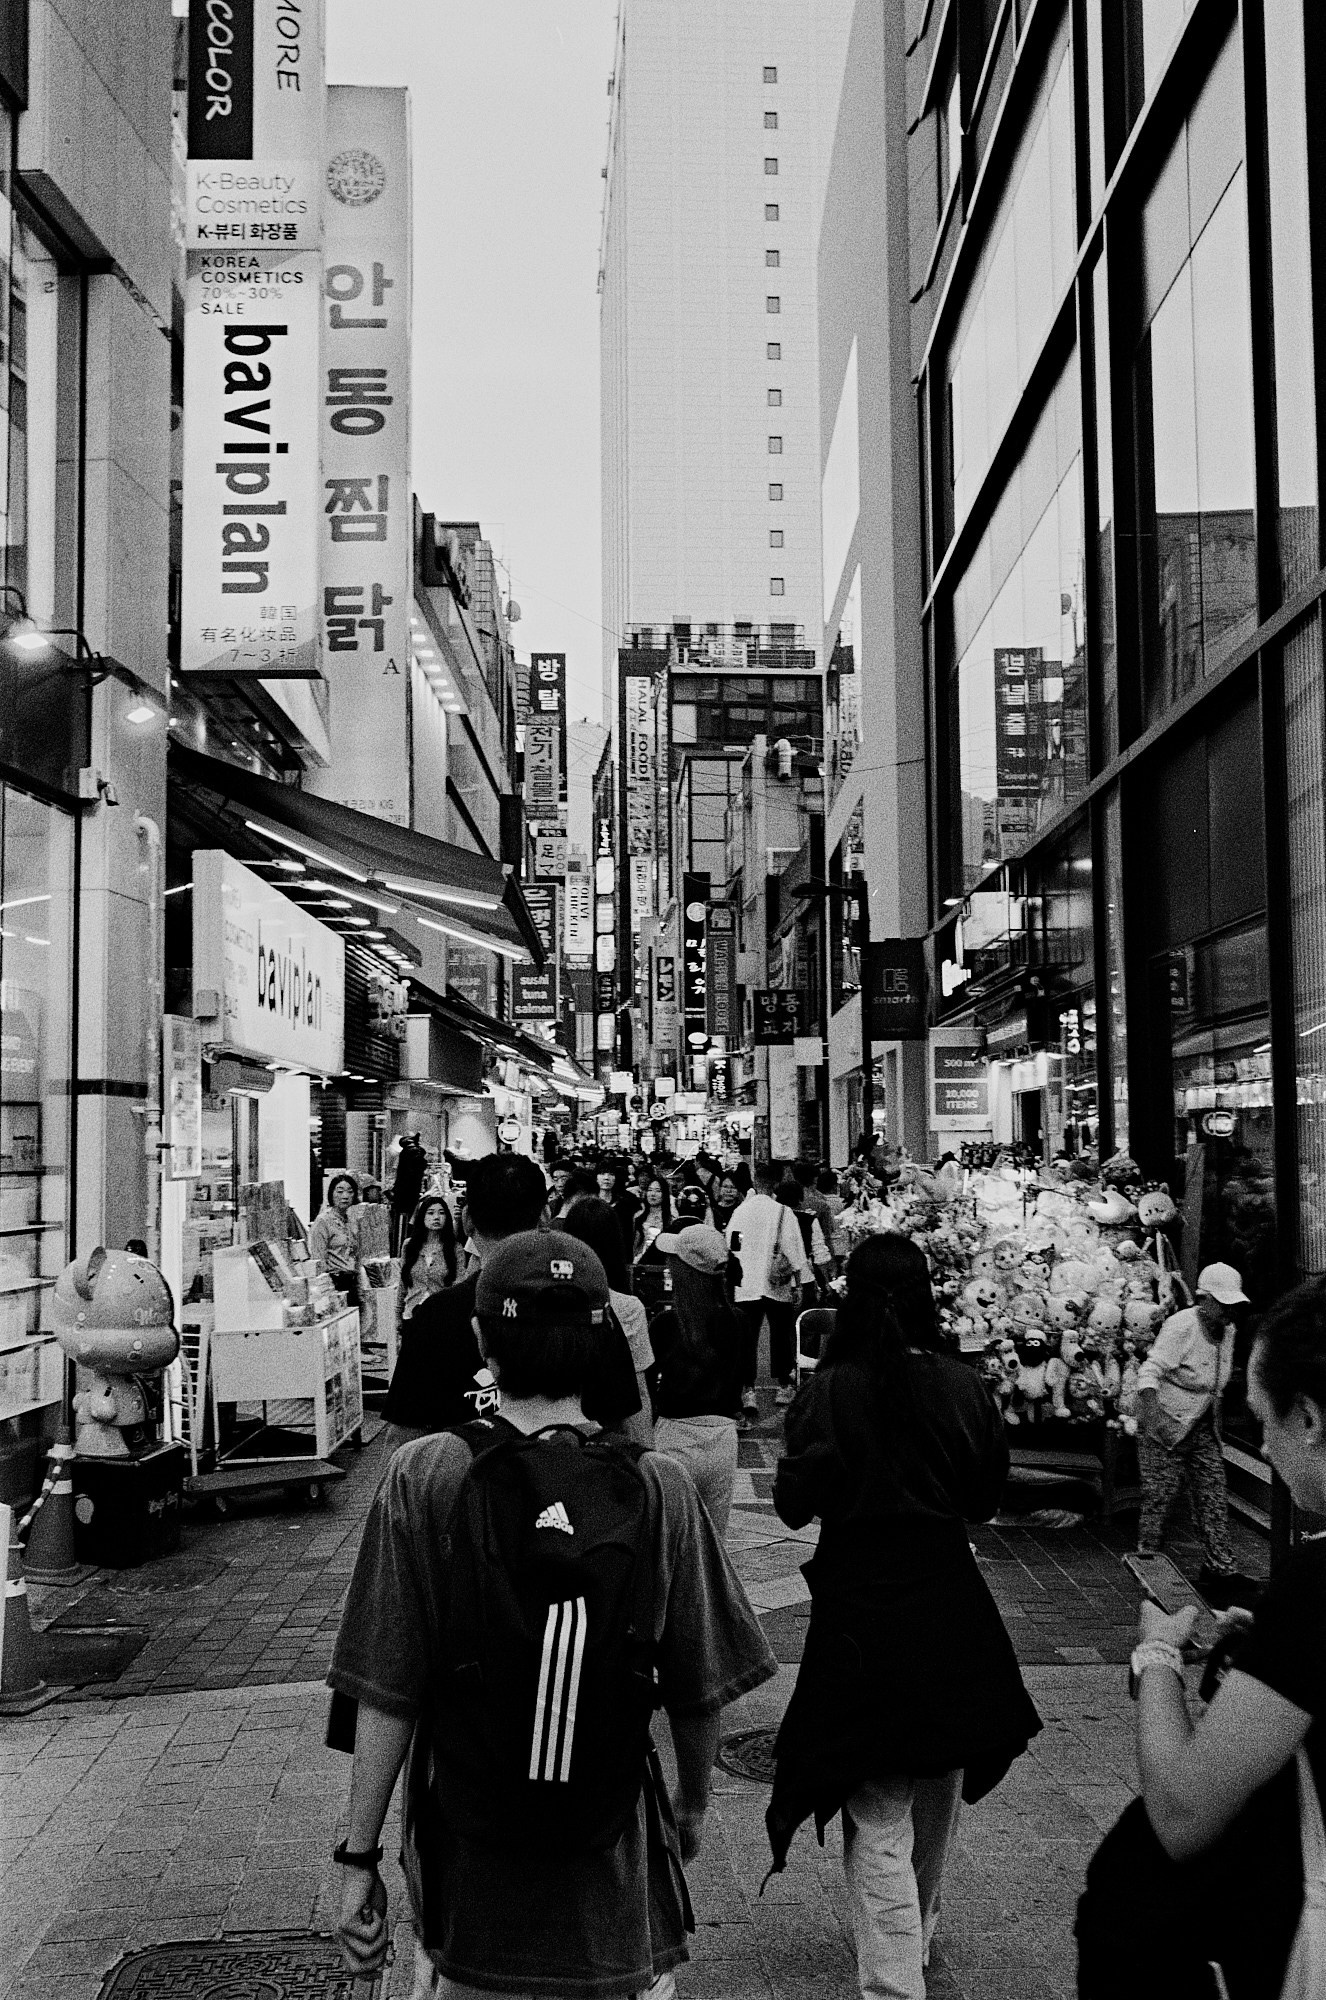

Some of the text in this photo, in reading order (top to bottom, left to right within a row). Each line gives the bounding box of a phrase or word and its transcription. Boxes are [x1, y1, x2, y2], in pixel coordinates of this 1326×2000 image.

[205, 0, 234, 120] COLOR
[196, 172, 296, 194] K-Beauty
[196, 195, 308, 214] Cosmetics
[197, 223, 299, 241] K-뷰티 화장품
[201, 256, 261, 268] KOREA
[201, 271, 304, 284] COSMETICS
[201, 302, 246, 315] SALE
[215, 324, 289, 594] baviplan
[638, 679, 649, 777] HALAL FOOD
[258, 918, 323, 1032] baviplan
[519, 974, 549, 985] sushi
[522, 988, 548, 999] tuna
[515, 1002, 555, 1014] salmon
[760, 993, 799, 1013] 명동
[945, 1089, 979, 1099] 10,000
[946, 1101, 978, 1109] ITEMS
[535, 1517, 574, 1535] adidas
